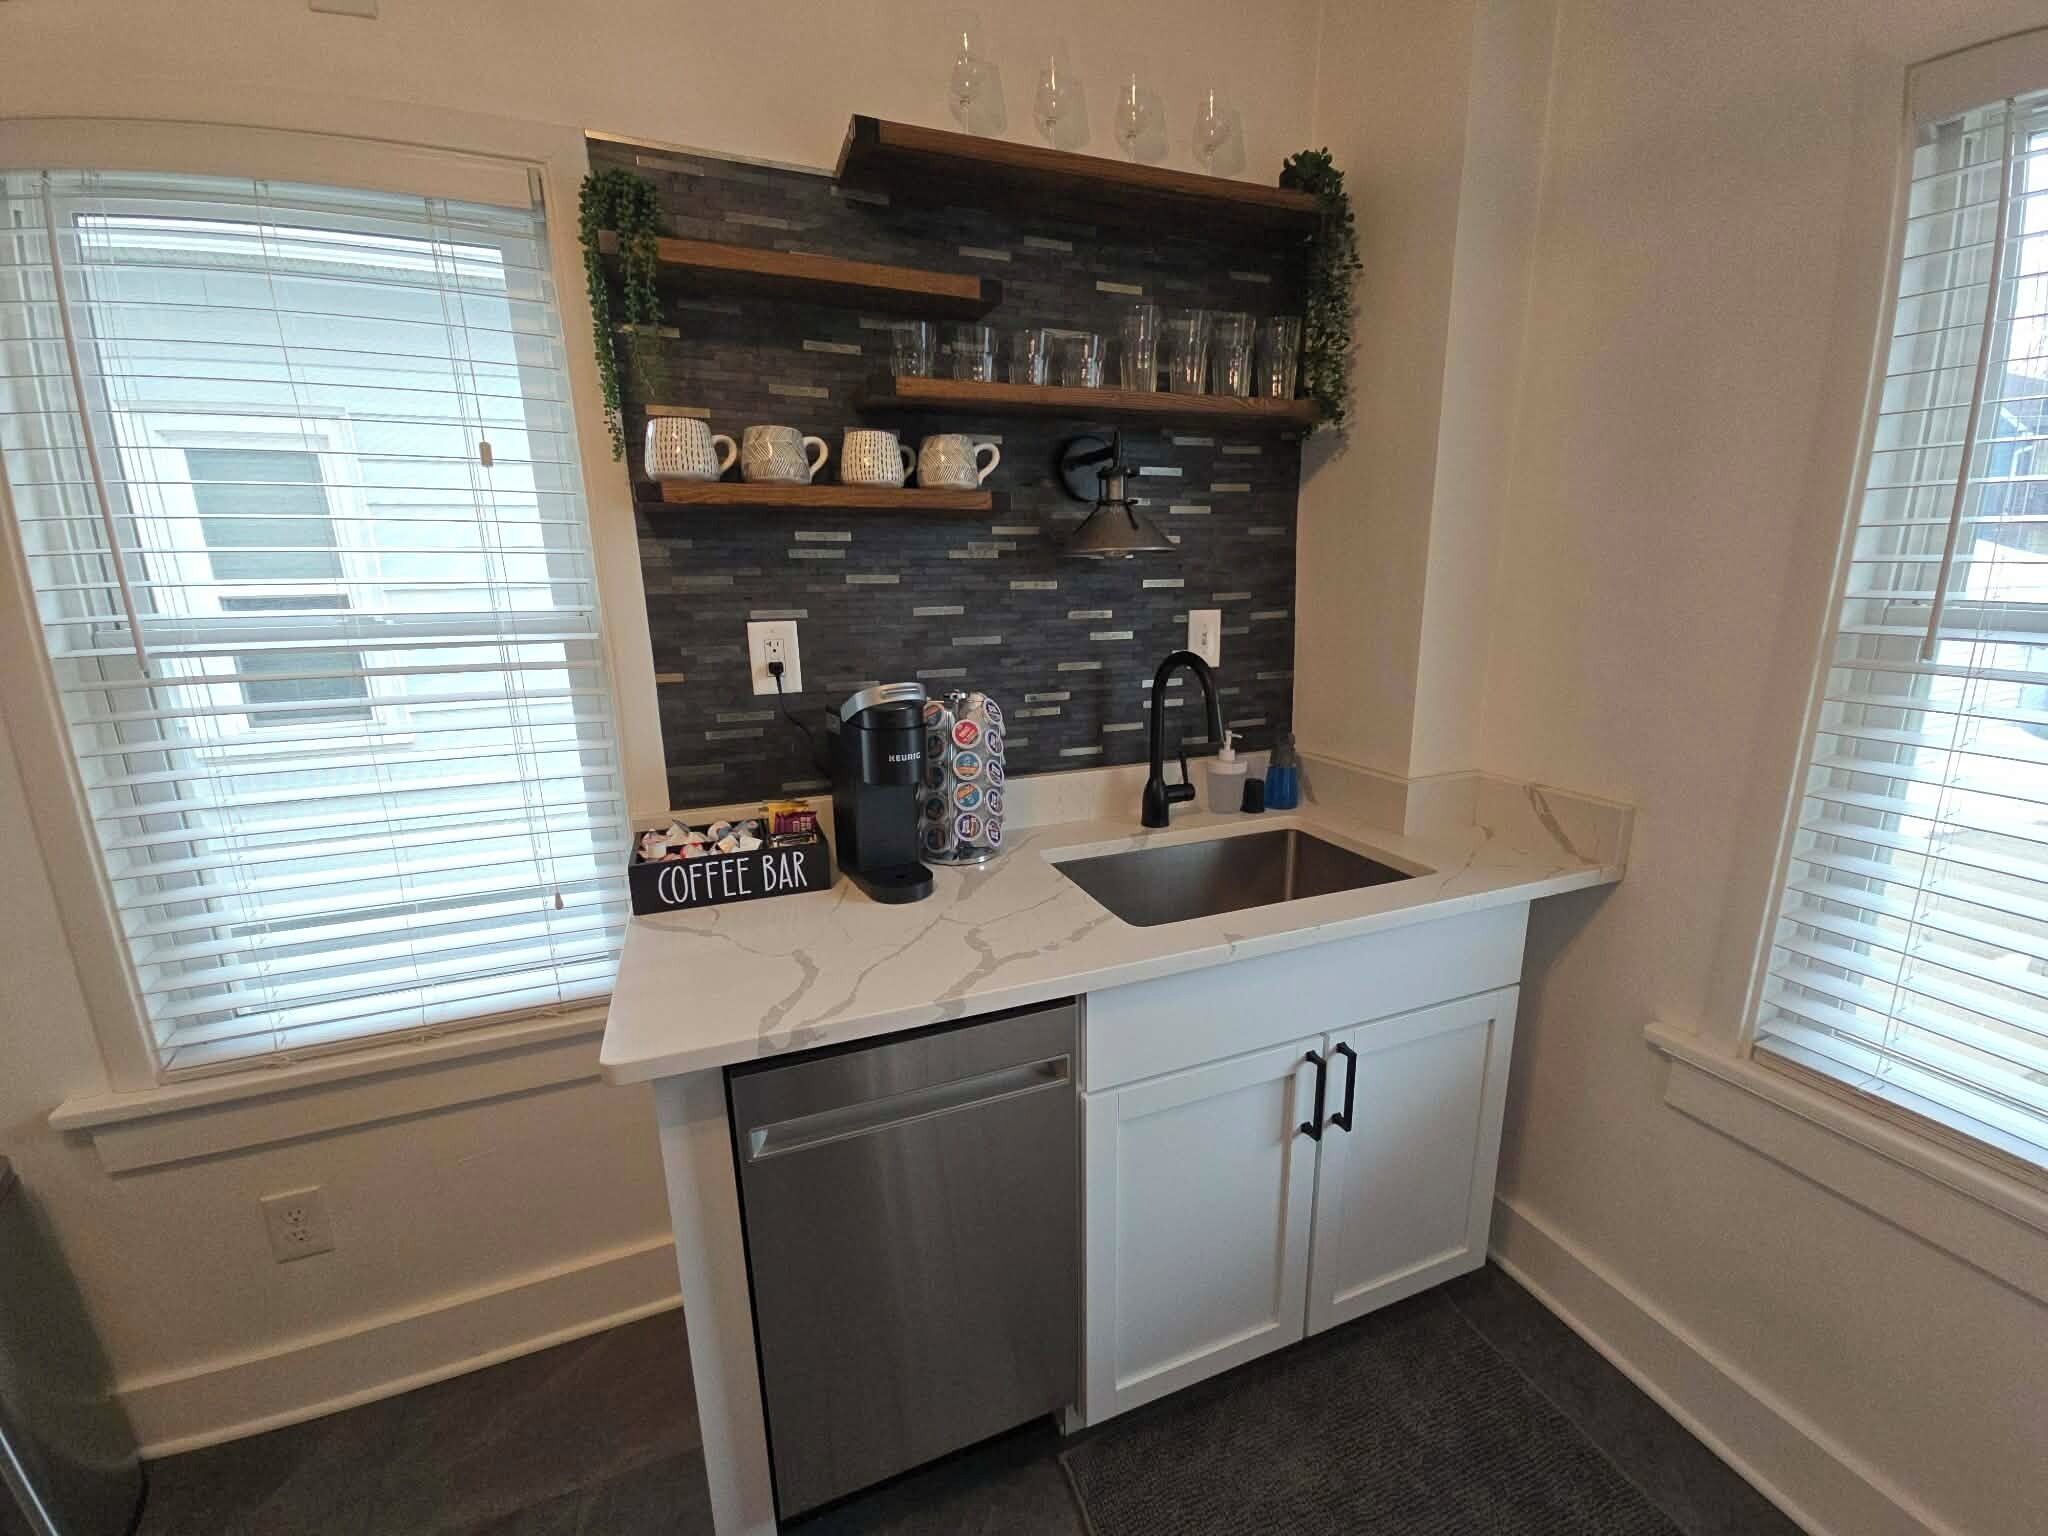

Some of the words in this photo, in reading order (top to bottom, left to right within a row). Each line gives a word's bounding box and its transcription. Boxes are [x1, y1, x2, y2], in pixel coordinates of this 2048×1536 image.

[888, 751, 921, 762] KEURIG
[658, 857, 752, 904] COFFEE
[762, 851, 808, 892] BAR
